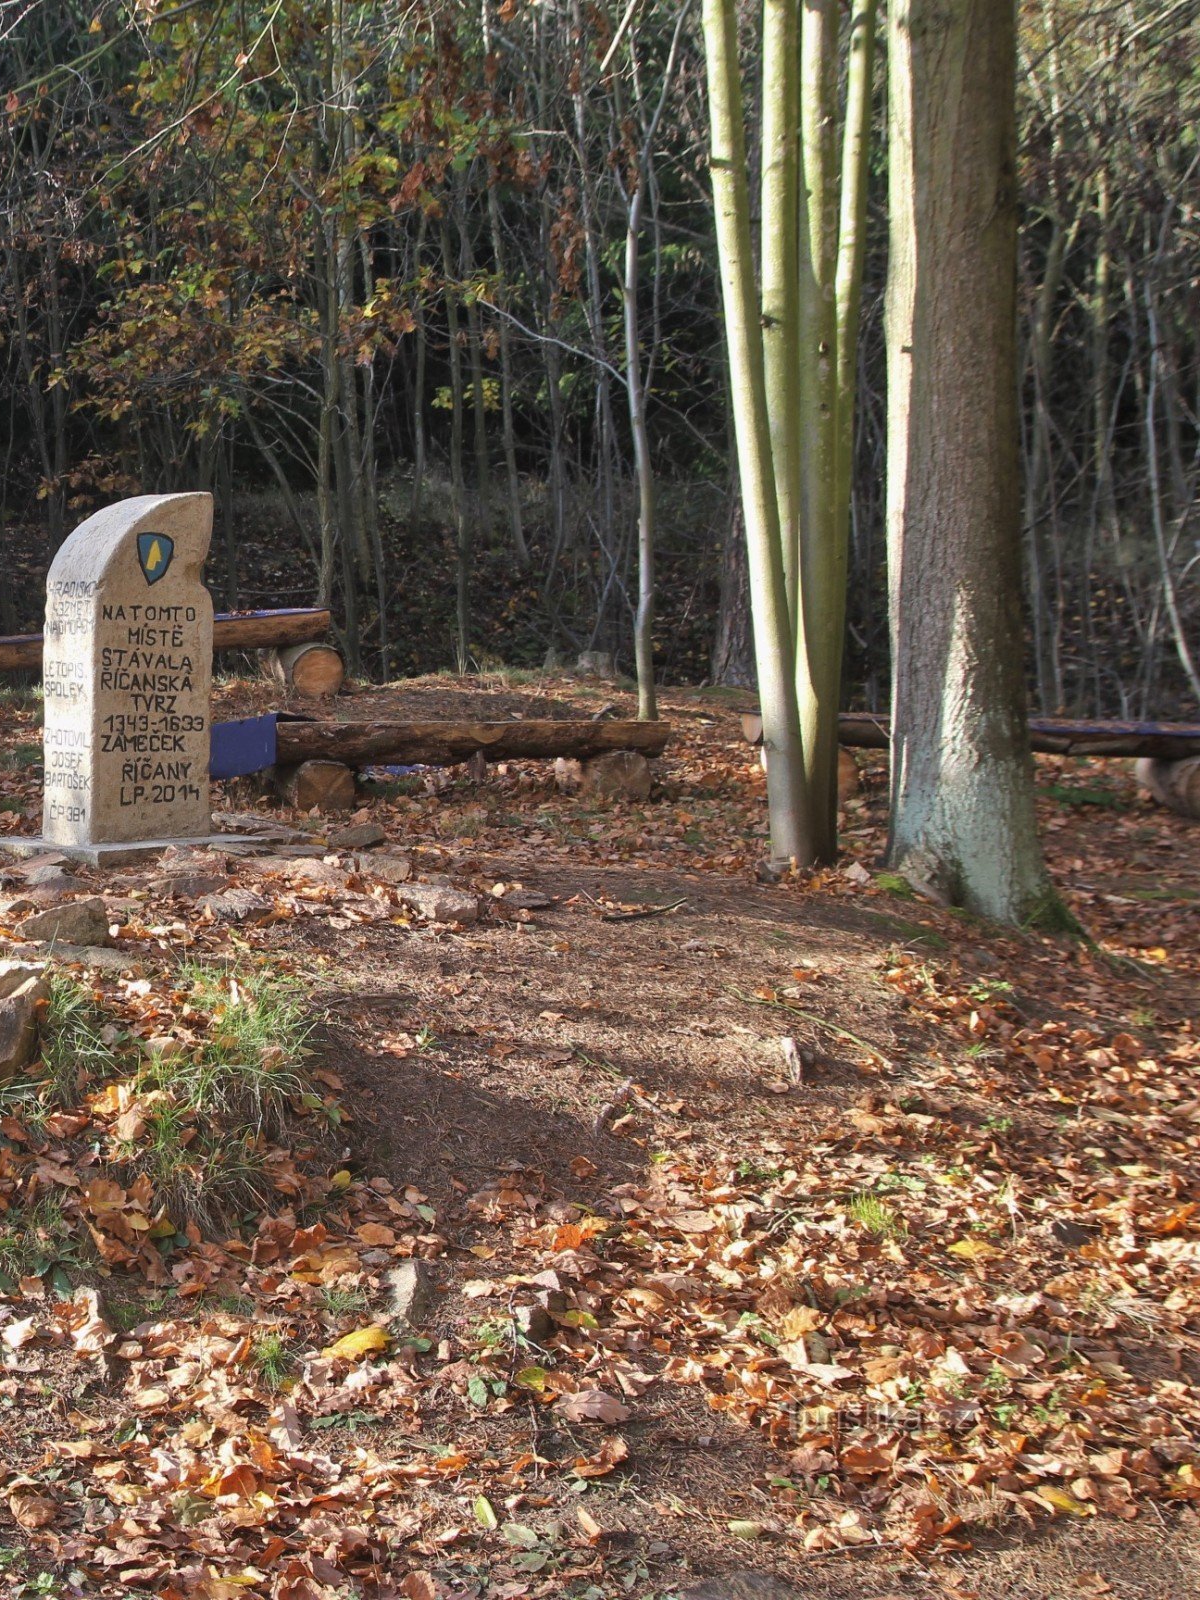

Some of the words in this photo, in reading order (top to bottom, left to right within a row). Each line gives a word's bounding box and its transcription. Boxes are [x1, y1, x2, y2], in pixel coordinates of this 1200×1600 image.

[130, 605, 196, 622] TOMTO
[128, 623, 184, 648] MÍSTĚ
[102, 647, 193, 671] STÁVALA
[101, 667, 193, 692] ŘÍČANSKÁ
[45, 681, 88, 701] SPOLEK
[130, 693, 178, 714] TVRZ
[103, 714, 205, 733] 1343-1633
[100, 729, 186, 753] ZÁMEČEK
[51, 751, 84, 769] JOSEF
[122, 756, 193, 783] ŘÍČANY
[44, 770, 91, 791] BARTOŠEK
